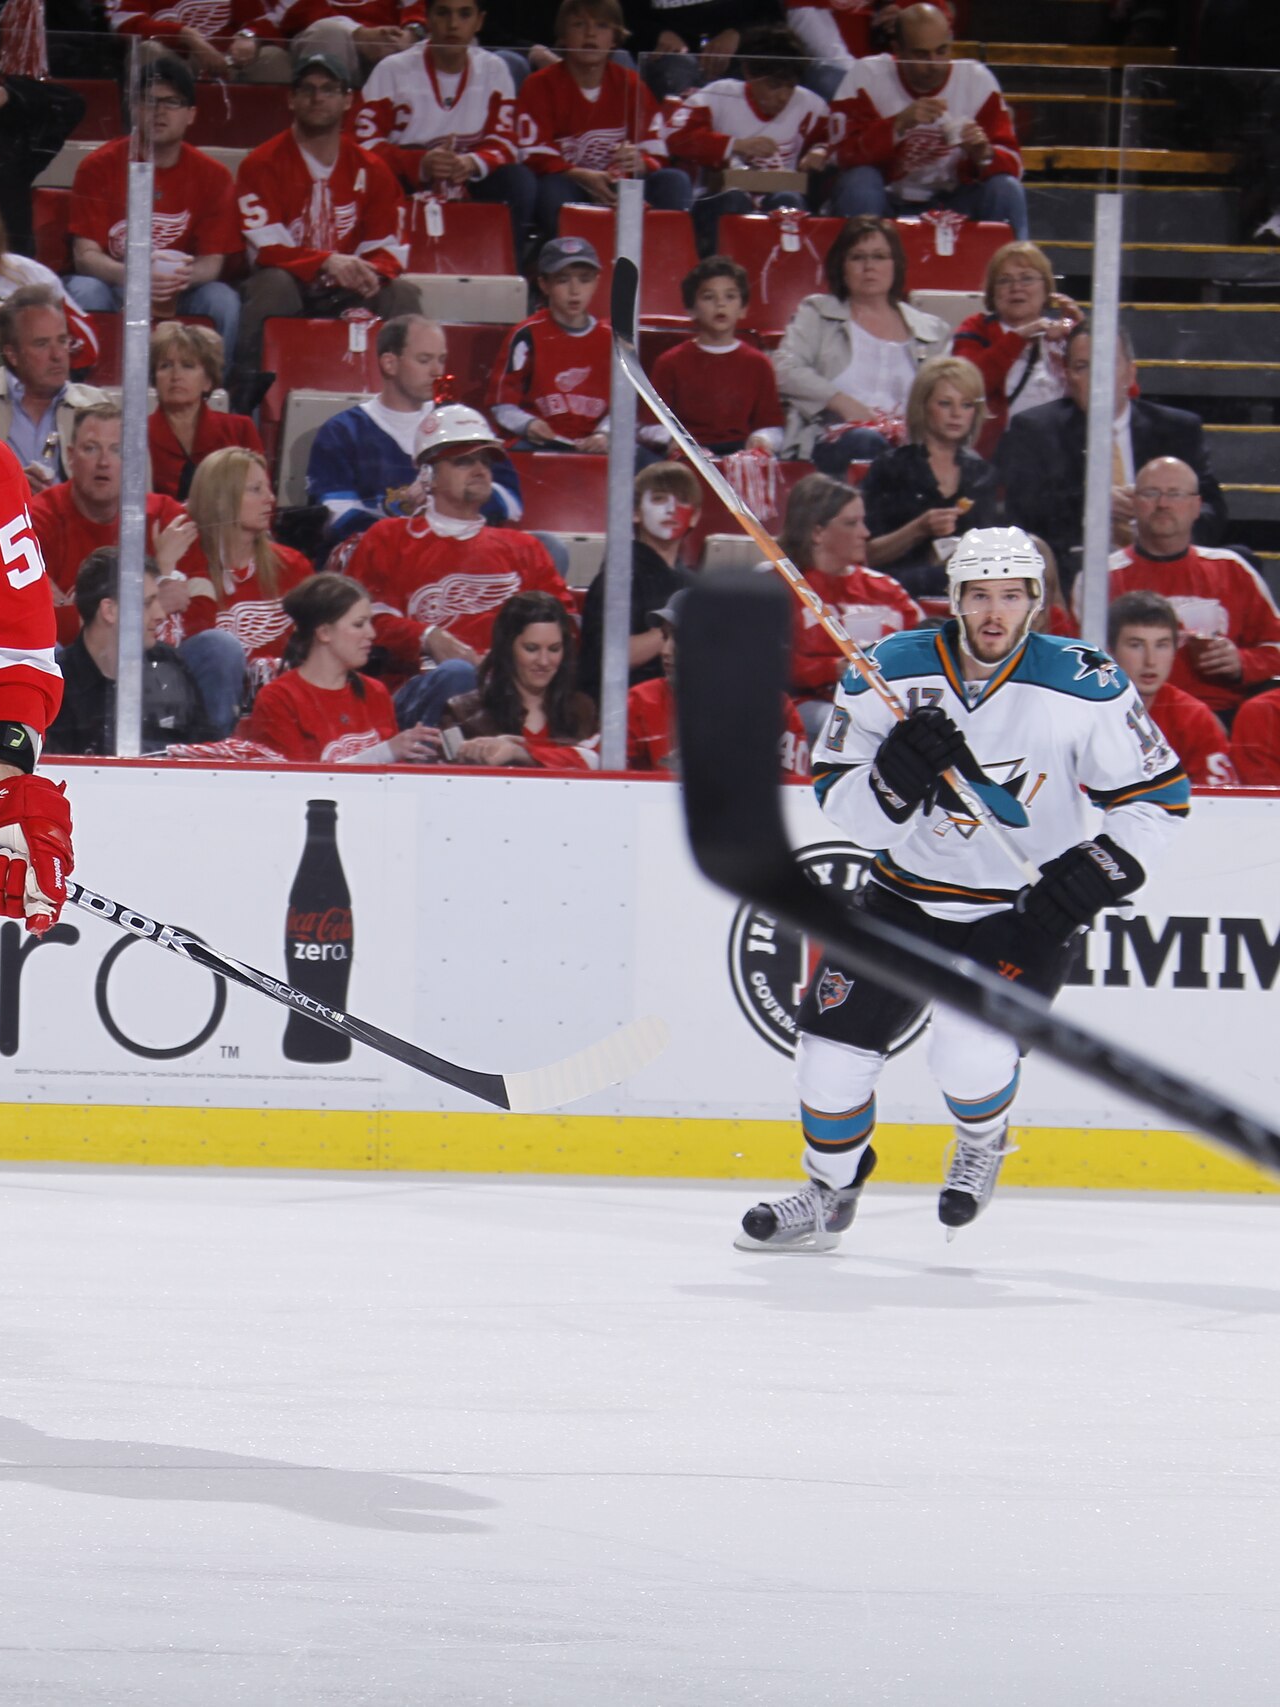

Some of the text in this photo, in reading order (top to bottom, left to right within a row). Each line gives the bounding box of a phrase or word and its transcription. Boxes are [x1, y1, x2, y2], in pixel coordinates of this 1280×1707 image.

[907, 687, 945, 719] 17
[51, 856, 63, 891] Reebok
[220, 1045, 240, 1059] TM
